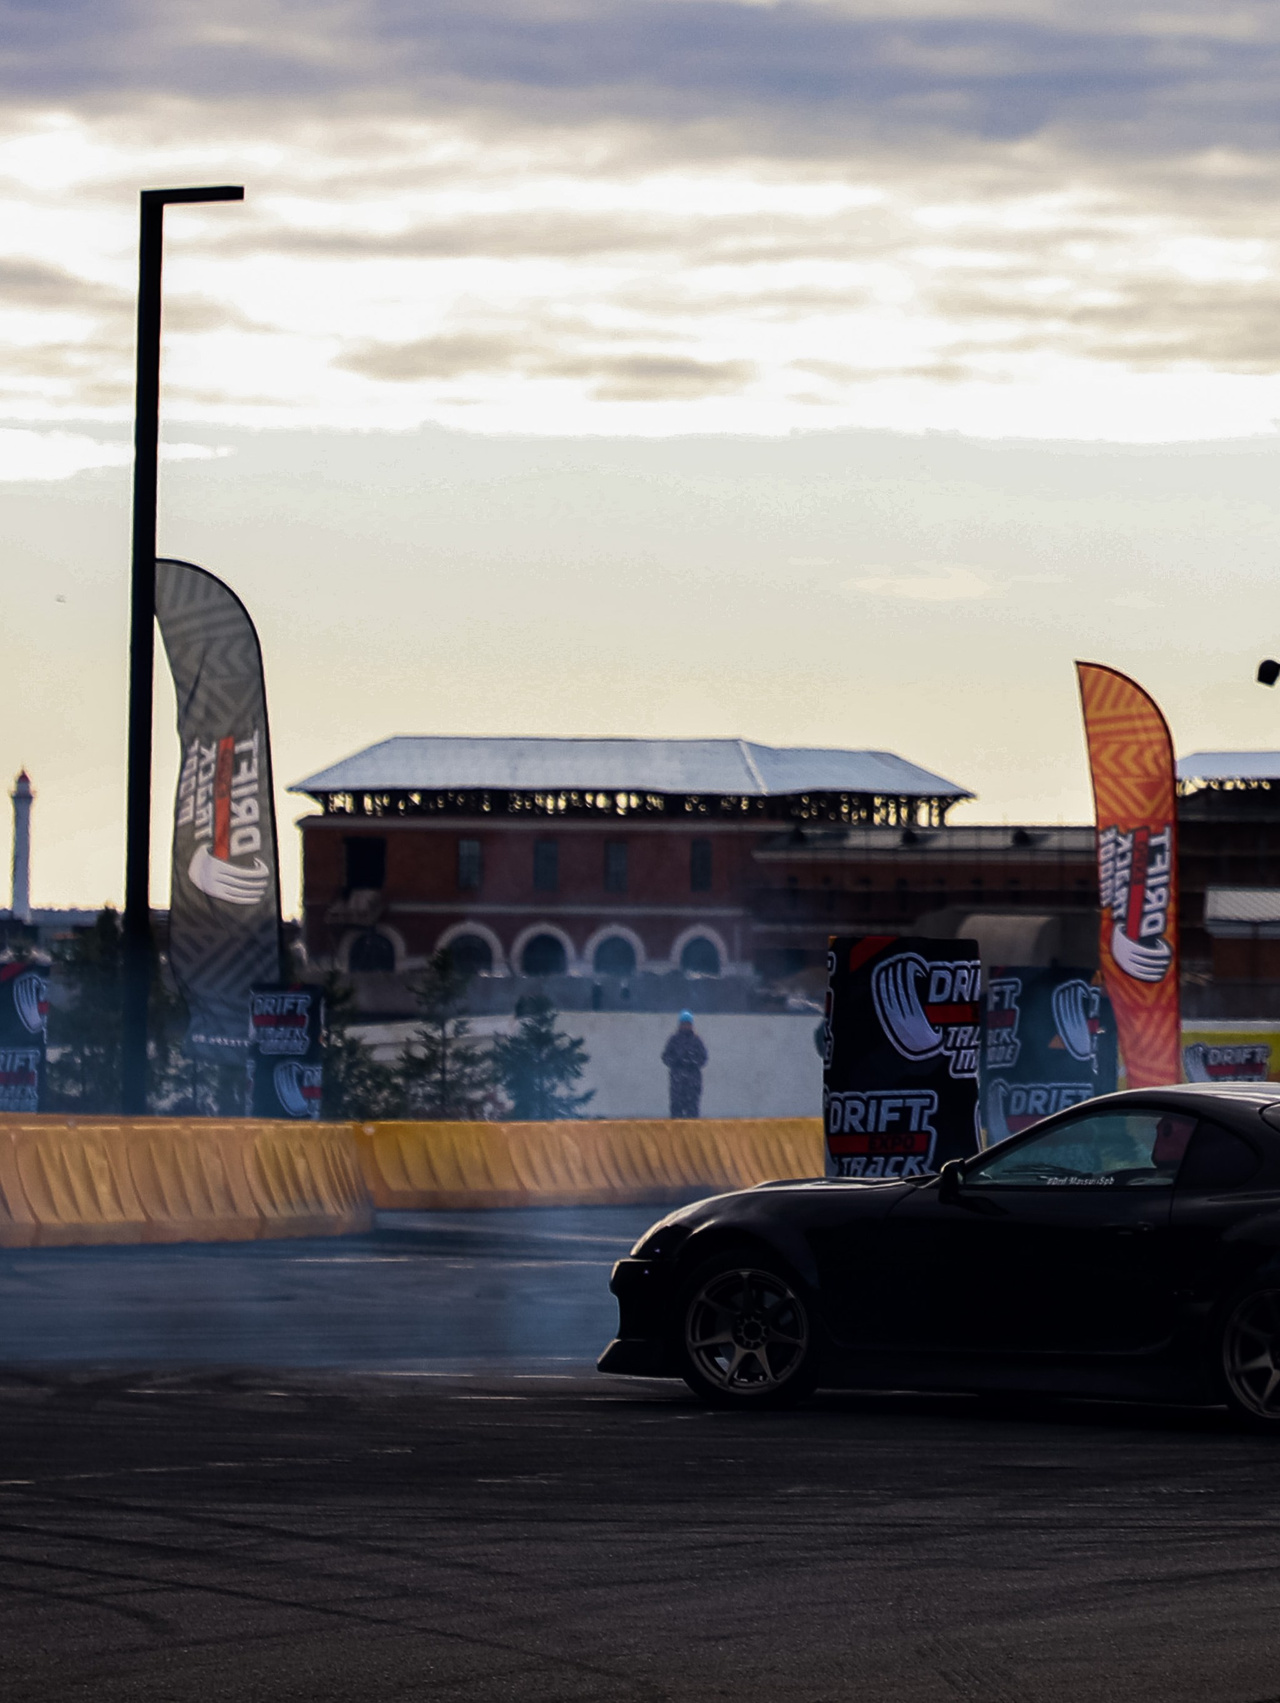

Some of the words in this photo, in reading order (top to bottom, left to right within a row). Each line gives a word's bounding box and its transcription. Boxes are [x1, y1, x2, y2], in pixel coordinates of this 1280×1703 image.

[928, 967, 981, 1003] DRI
[829, 1098, 931, 1133] DRIFT
[868, 1135, 915, 1151] EXPO
